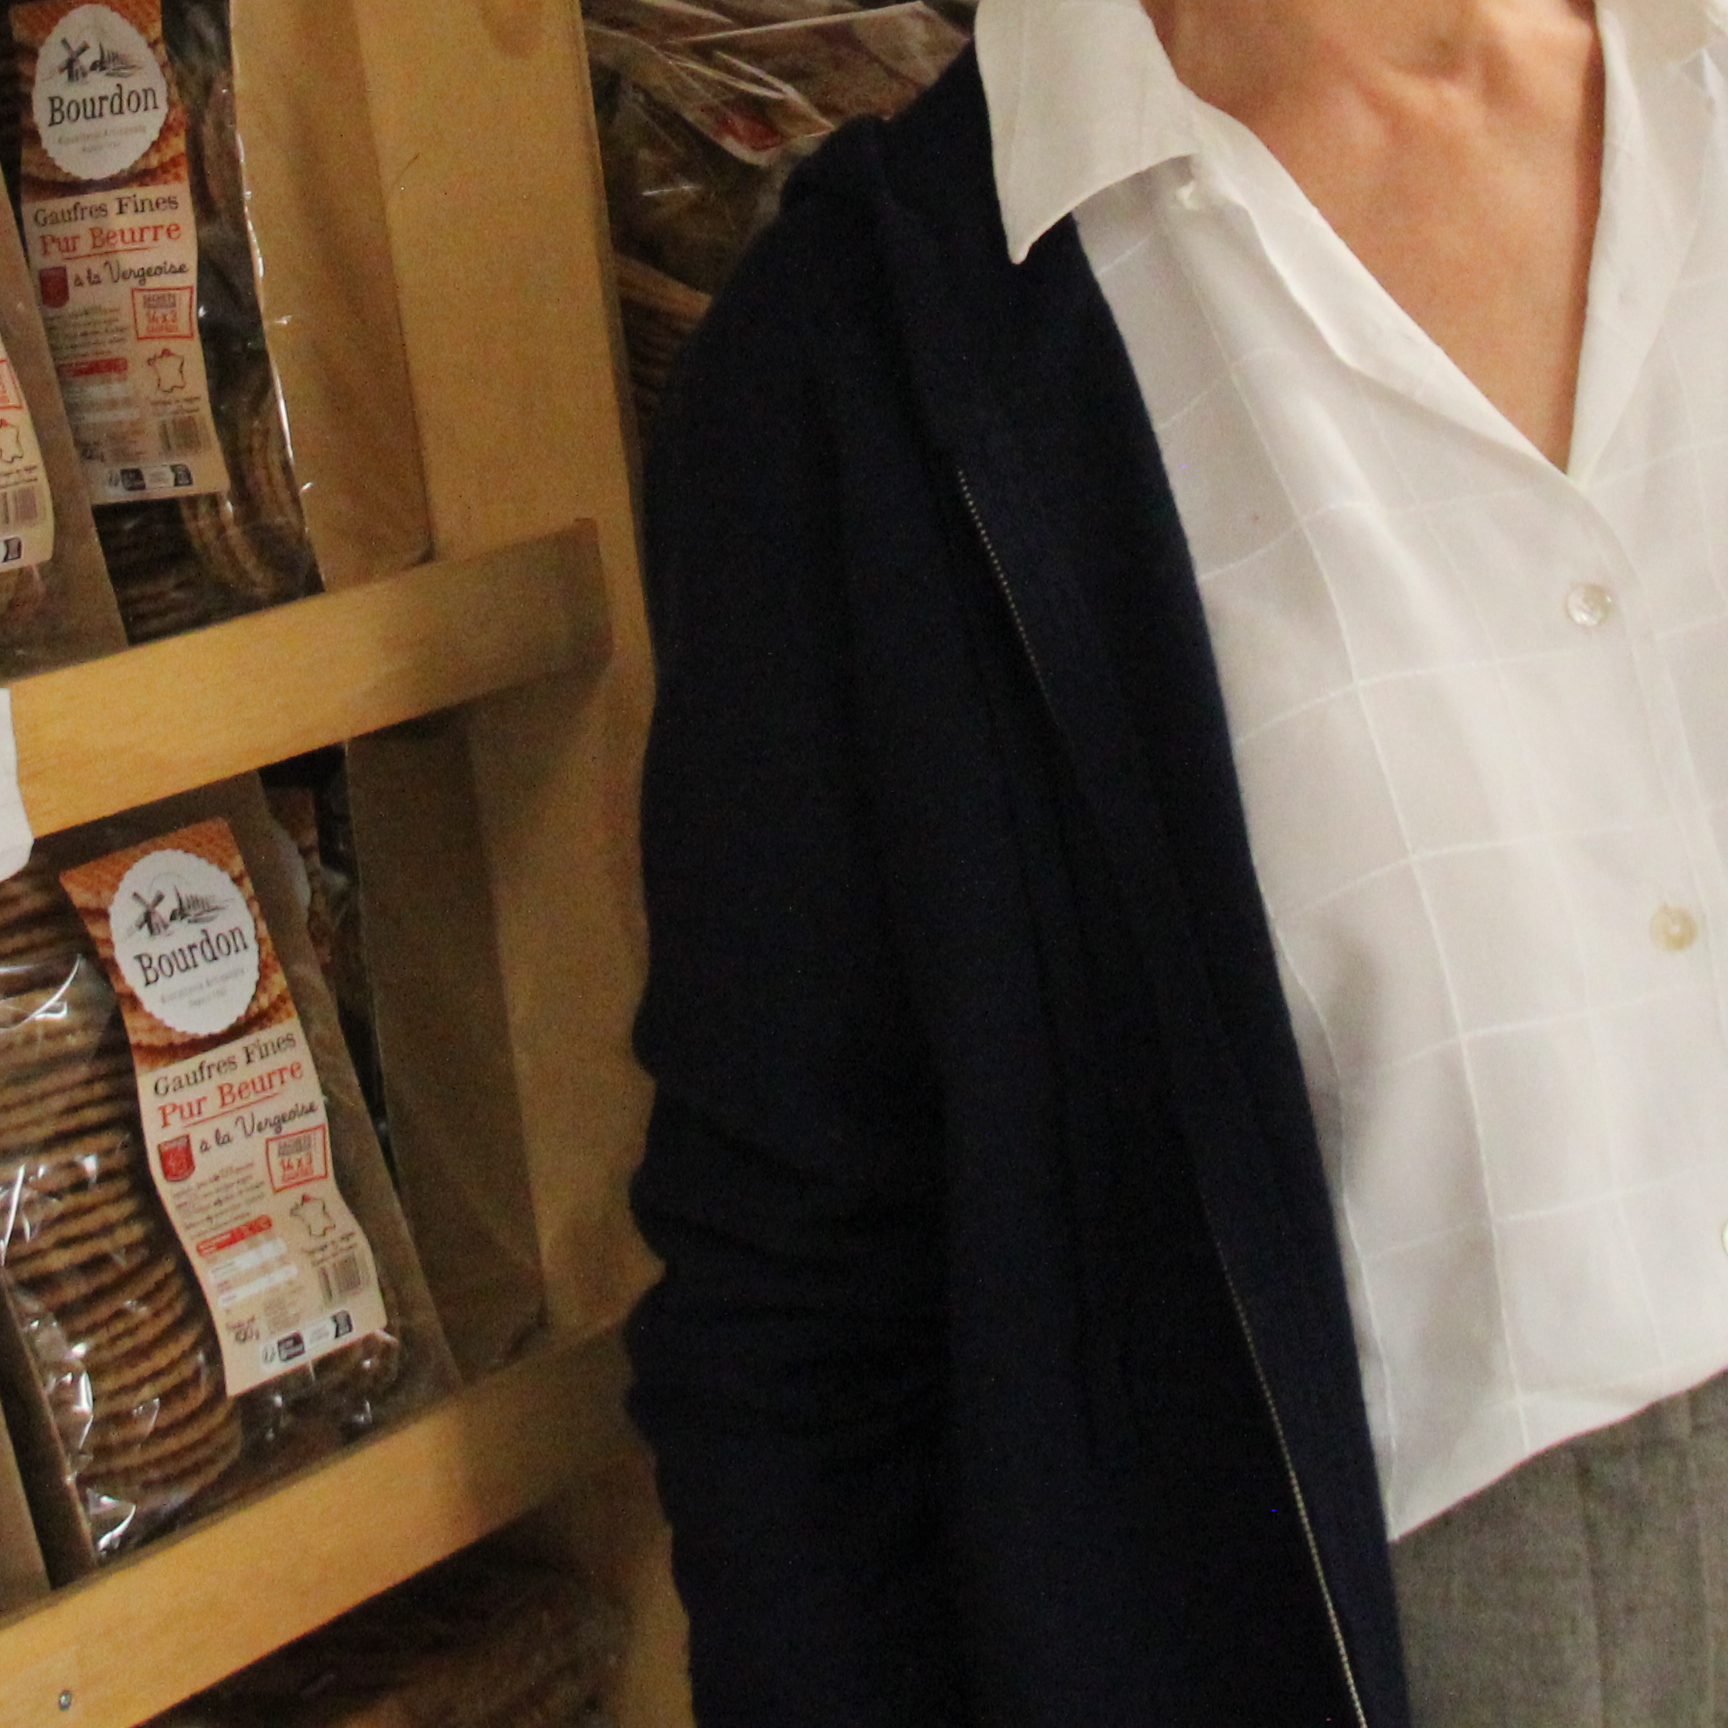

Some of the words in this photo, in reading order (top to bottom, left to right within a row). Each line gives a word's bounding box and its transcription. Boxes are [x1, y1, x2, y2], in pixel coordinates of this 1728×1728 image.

[48, 84, 159, 127] Bourdon
[34, 200, 108, 227] Gaufres
[116, 193, 179, 216] Fines
[39, 233, 81, 256] Pur
[89, 221, 182, 250] Beurre
[133, 926, 249, 987] Bourdon
[154, 1056, 238, 1098] Gaufres
[244, 1031, 296, 1065] Fines
[159, 1097, 207, 1129] Pur
[217, 1062, 304, 1109] Beurre
[215, 1128, 232, 1147] la
[235, 1101, 319, 1137] Vergeoise
